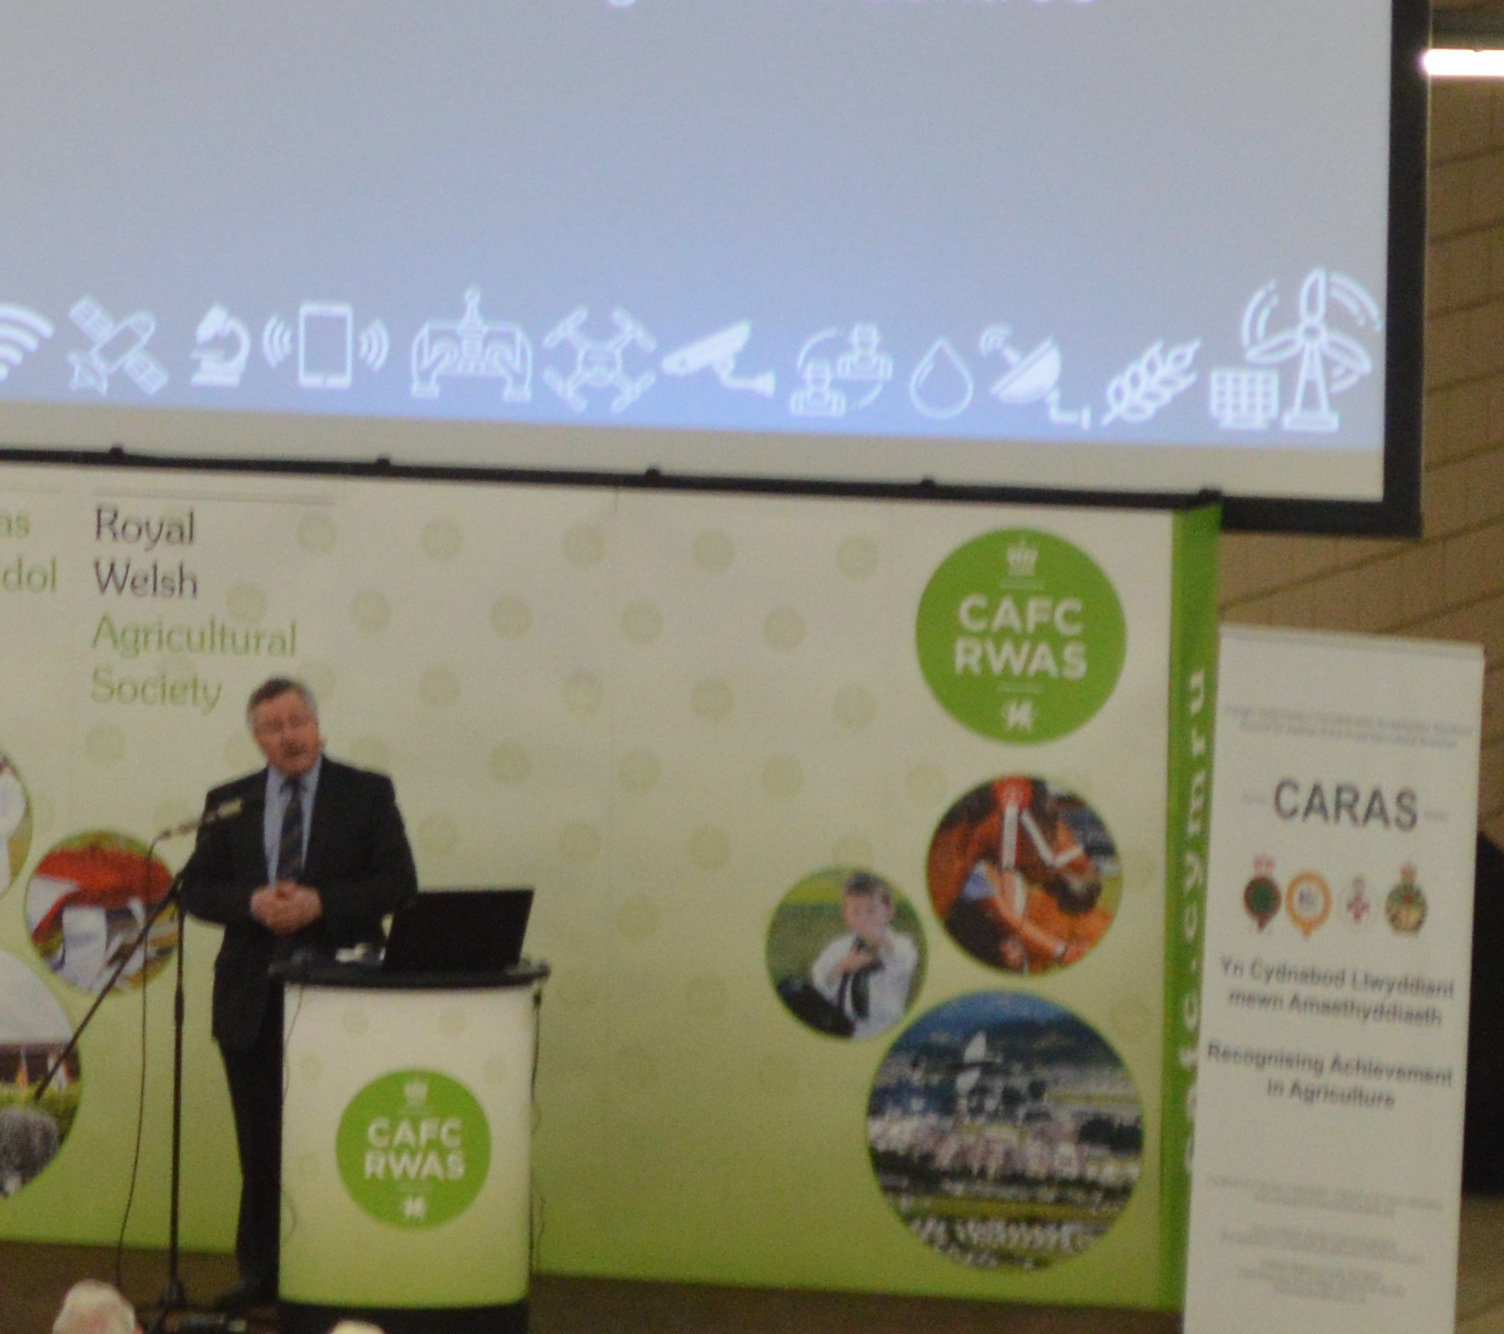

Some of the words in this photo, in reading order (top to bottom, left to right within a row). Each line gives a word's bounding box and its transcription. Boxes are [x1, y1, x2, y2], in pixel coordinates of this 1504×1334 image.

[93, 505, 196, 551] Royal
[93, 559, 199, 600] Welsh
[92, 613, 298, 663] Agricultural
[958, 594, 1084, 636] CAFC
[953, 635, 1088, 681] RWAS
[91, 668, 222, 716] Society
[1273, 778, 1419, 832] CARAS
[1207, 1040, 1325, 1075] Recognising
[1330, 1052, 1454, 1088] Achievement
[1290, 1080, 1396, 1110] Agriculture
[366, 1117, 463, 1147] CAFC
[363, 1148, 466, 1181] RWAS
